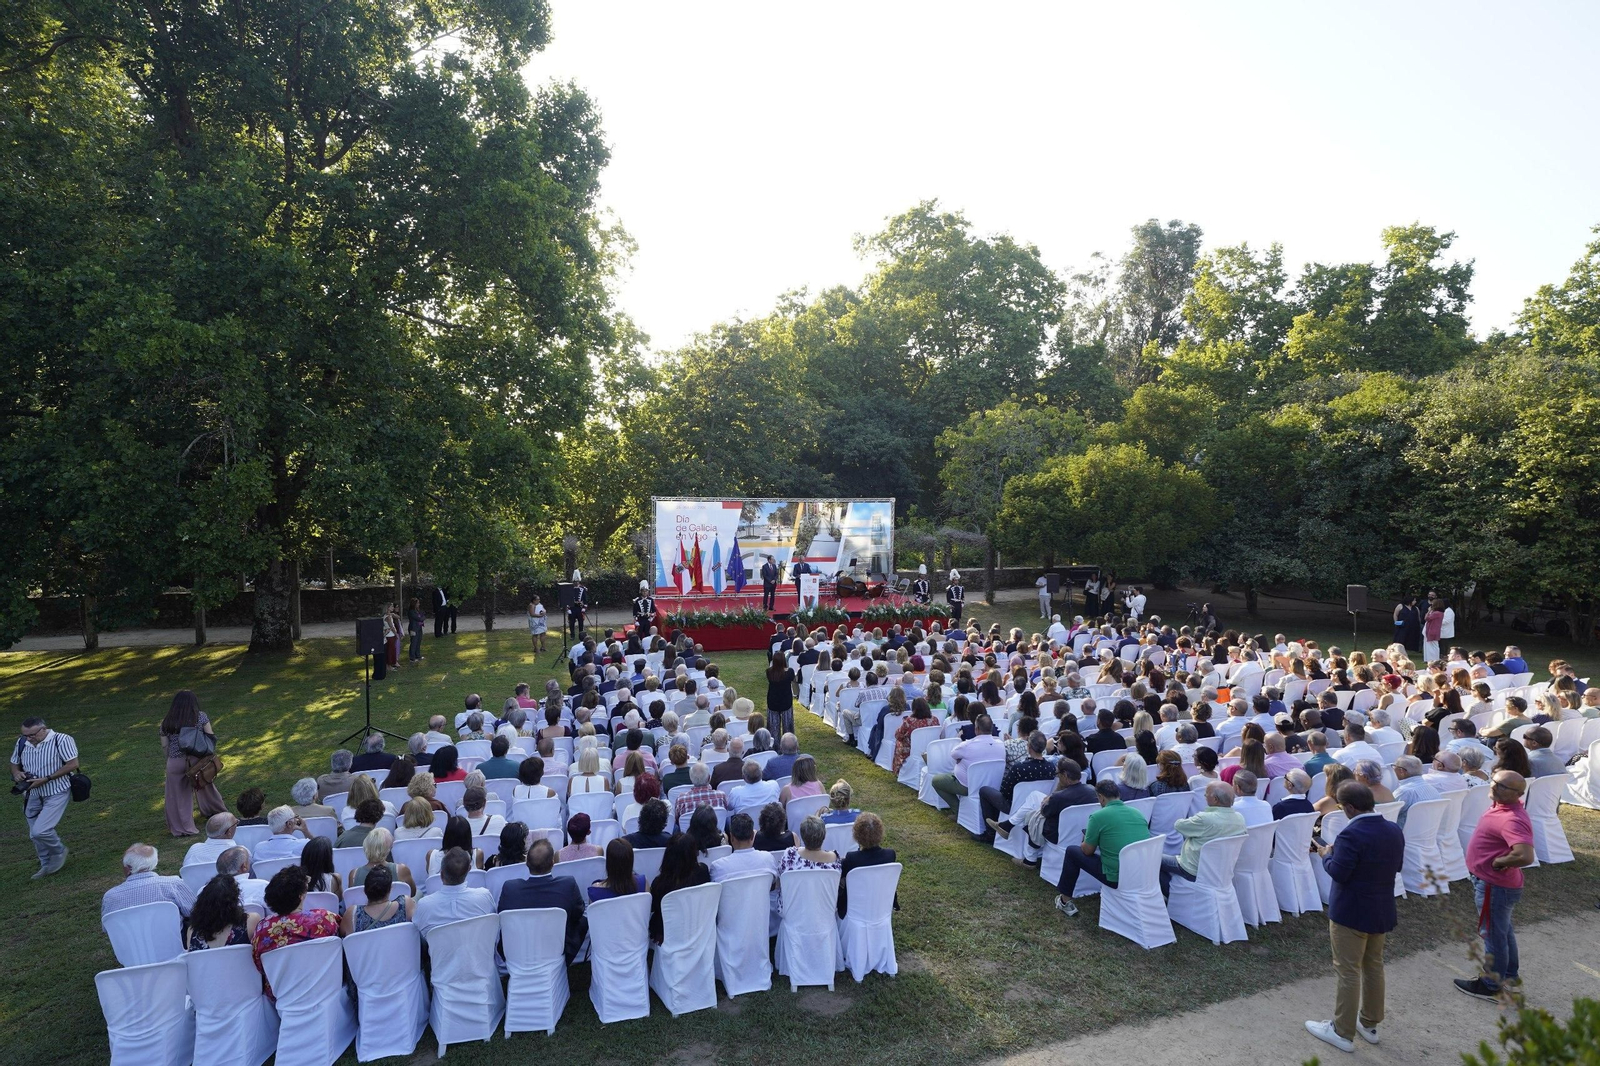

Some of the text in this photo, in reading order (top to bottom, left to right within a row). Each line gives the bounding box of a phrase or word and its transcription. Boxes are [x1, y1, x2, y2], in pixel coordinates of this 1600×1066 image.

[676, 524, 718, 532] de Galicia
[688, 532, 708, 542] Vgo
